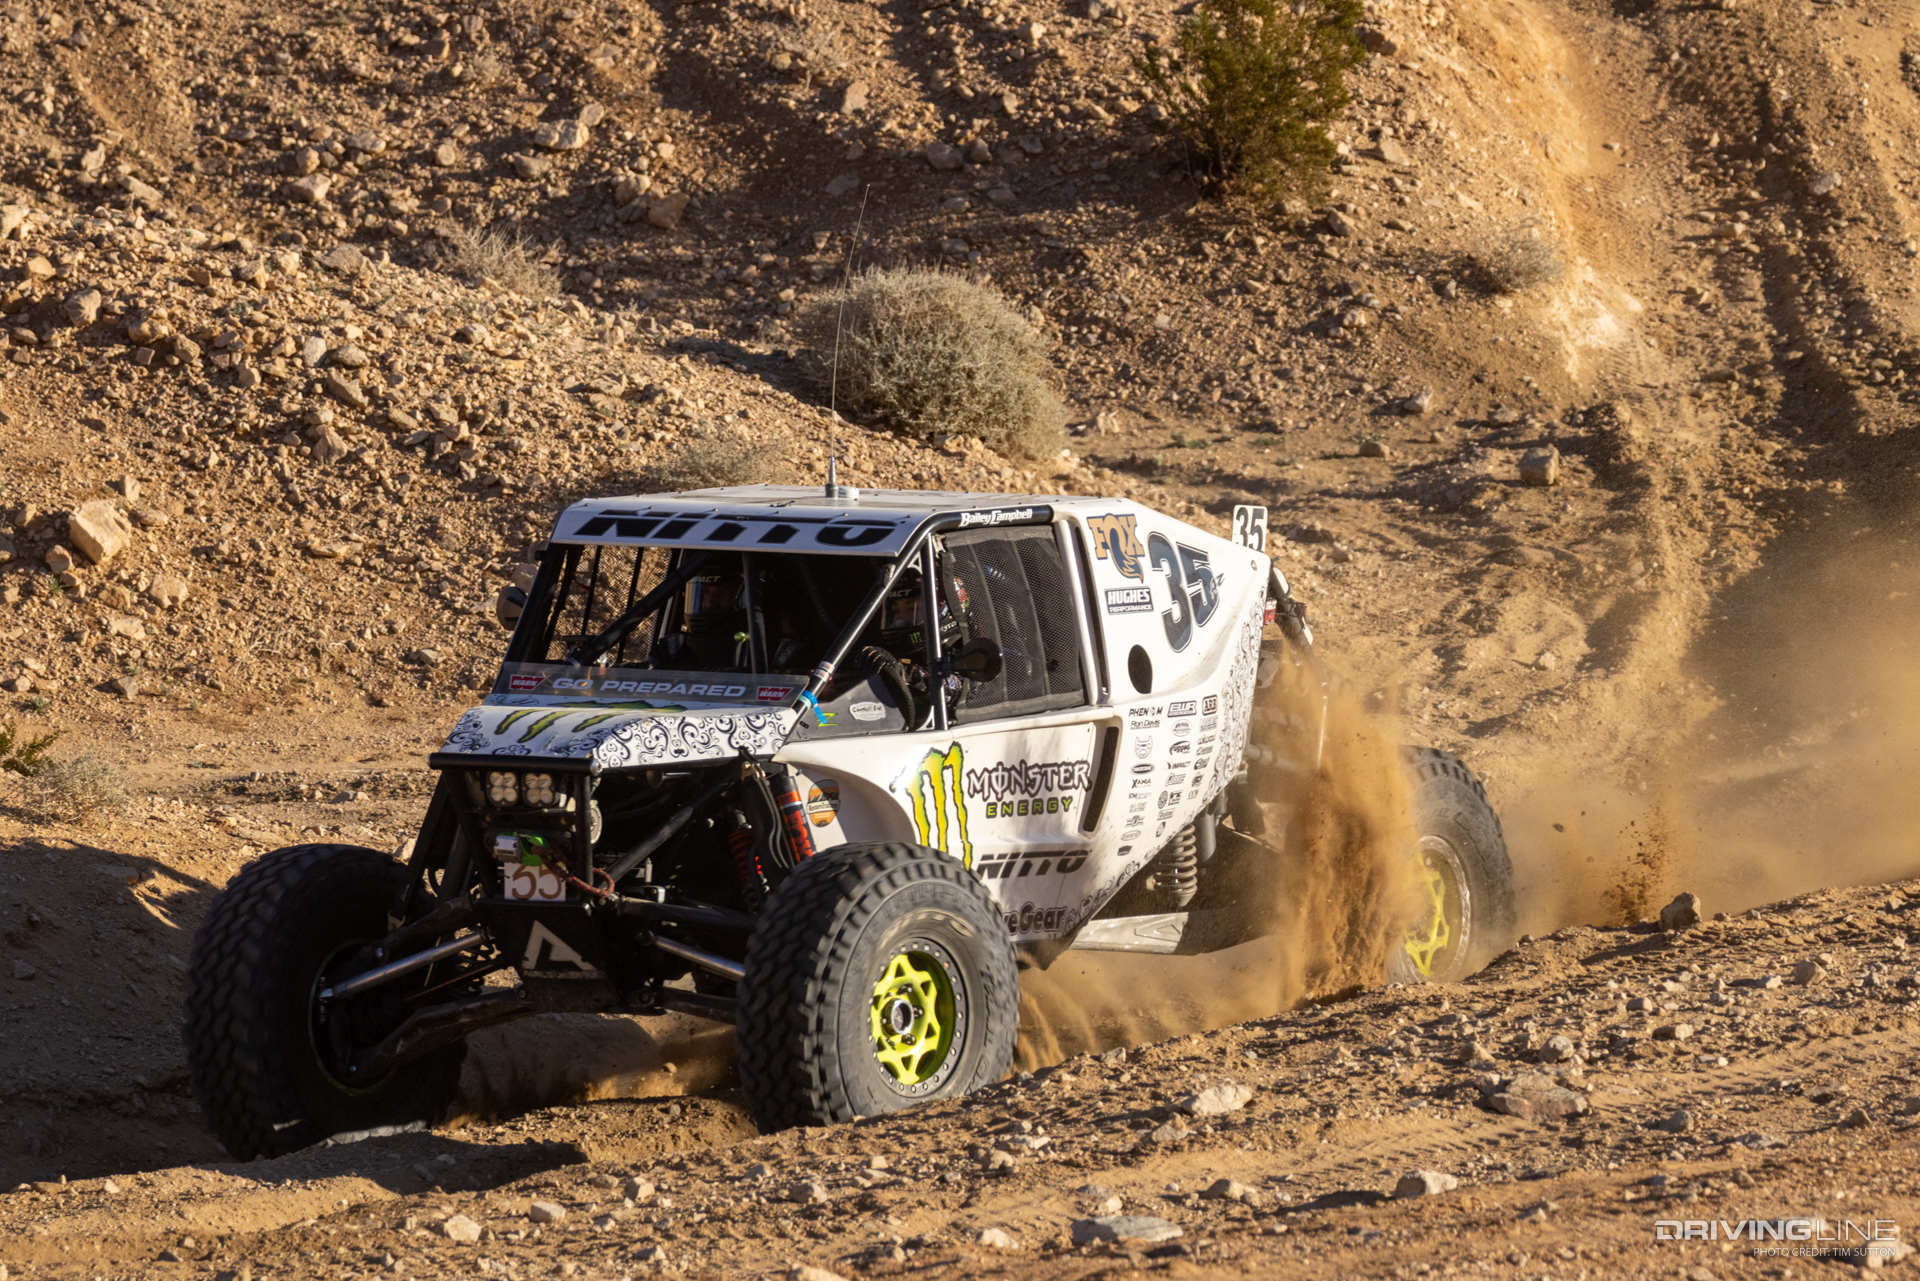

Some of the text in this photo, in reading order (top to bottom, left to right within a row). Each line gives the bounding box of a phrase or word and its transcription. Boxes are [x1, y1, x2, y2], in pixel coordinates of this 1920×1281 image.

[573, 508, 898, 546] NITTO
[959, 508, 1033, 528] Bailey Campbell
[1235, 507, 1265, 553] 35
[1087, 513, 1145, 584] FOX
[1107, 588, 1150, 605] HUGHES
[1147, 531, 1220, 653] 35
[1109, 604, 1153, 613] PERFORMANCE
[512, 679, 539, 687] WARN
[552, 677, 747, 697] GO PREPARED
[759, 690, 786, 698] WARN
[966, 759, 1092, 802] MONSTER
[986, 796, 1073, 818] ENERGY
[977, 849, 1089, 879] NITTO
